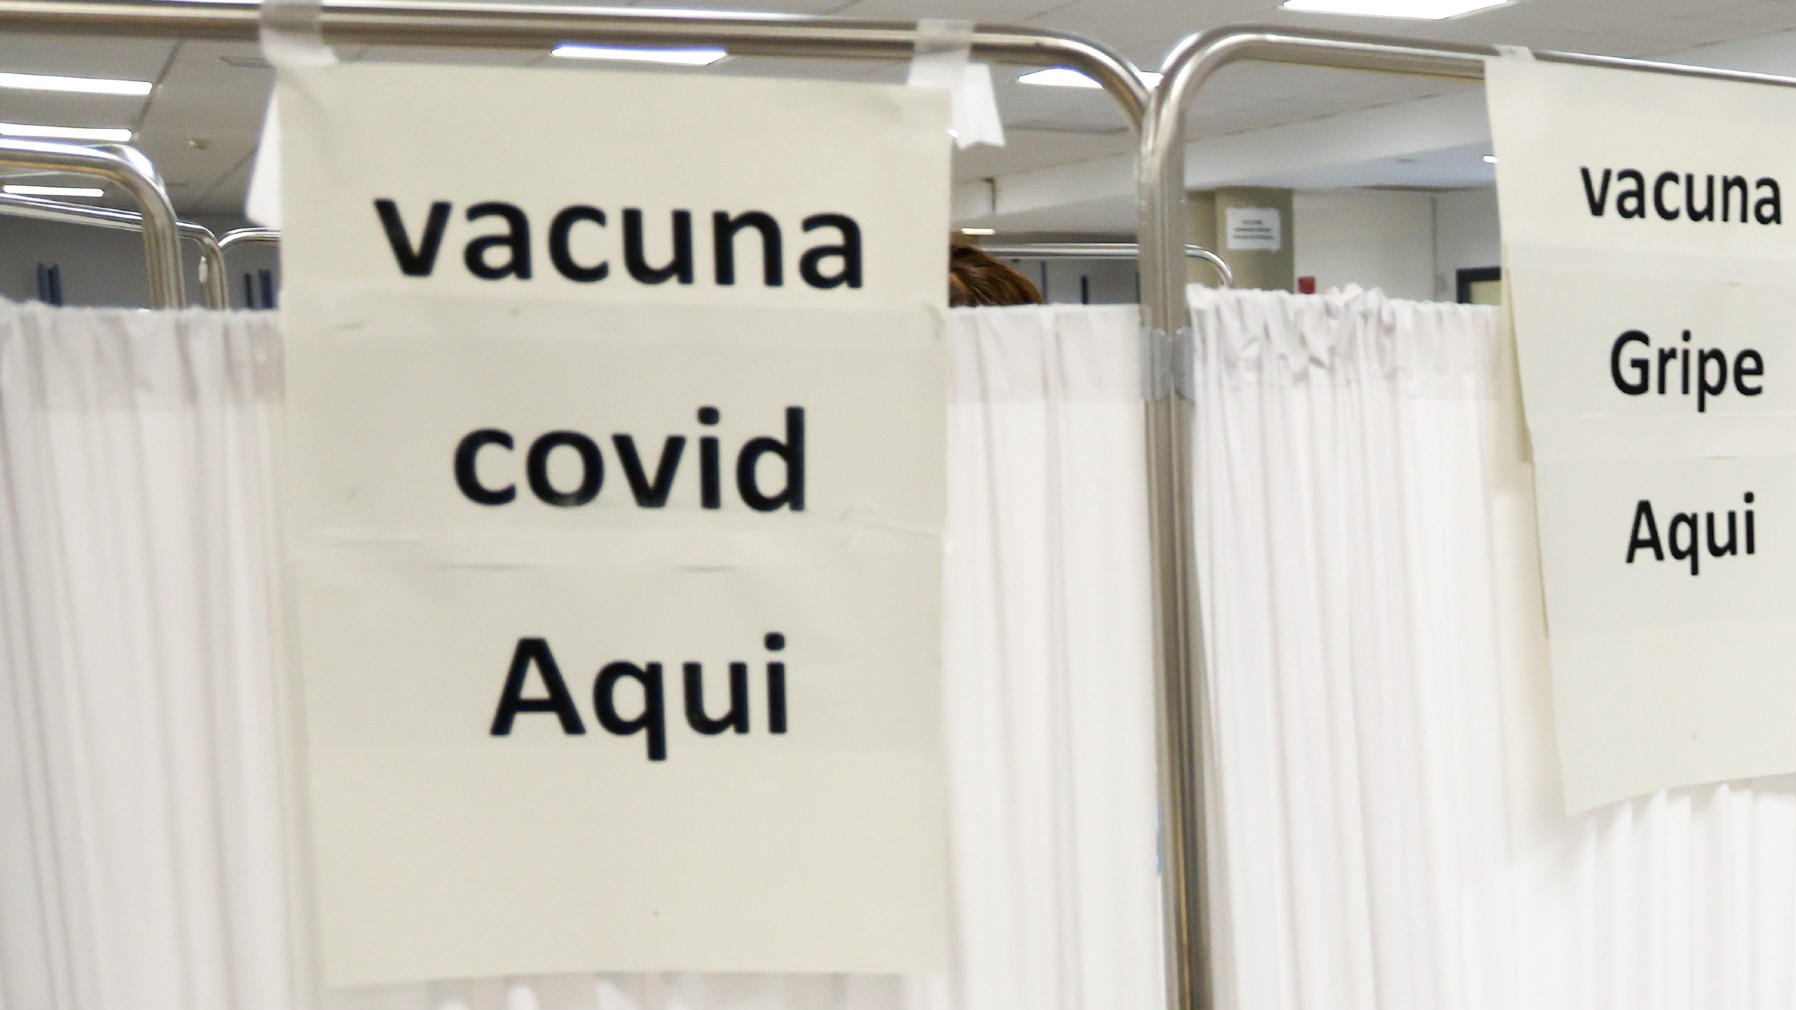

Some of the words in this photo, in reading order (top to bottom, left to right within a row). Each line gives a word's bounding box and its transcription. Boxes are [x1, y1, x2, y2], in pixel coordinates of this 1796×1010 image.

[1580, 167, 1782, 226] vacuna
[374, 198, 863, 290] vacuna
[1610, 329, 1765, 413] Gripe
[454, 406, 806, 513] covid
[1625, 491, 1756, 577] Aqui
[490, 632, 788, 762] Aqui
